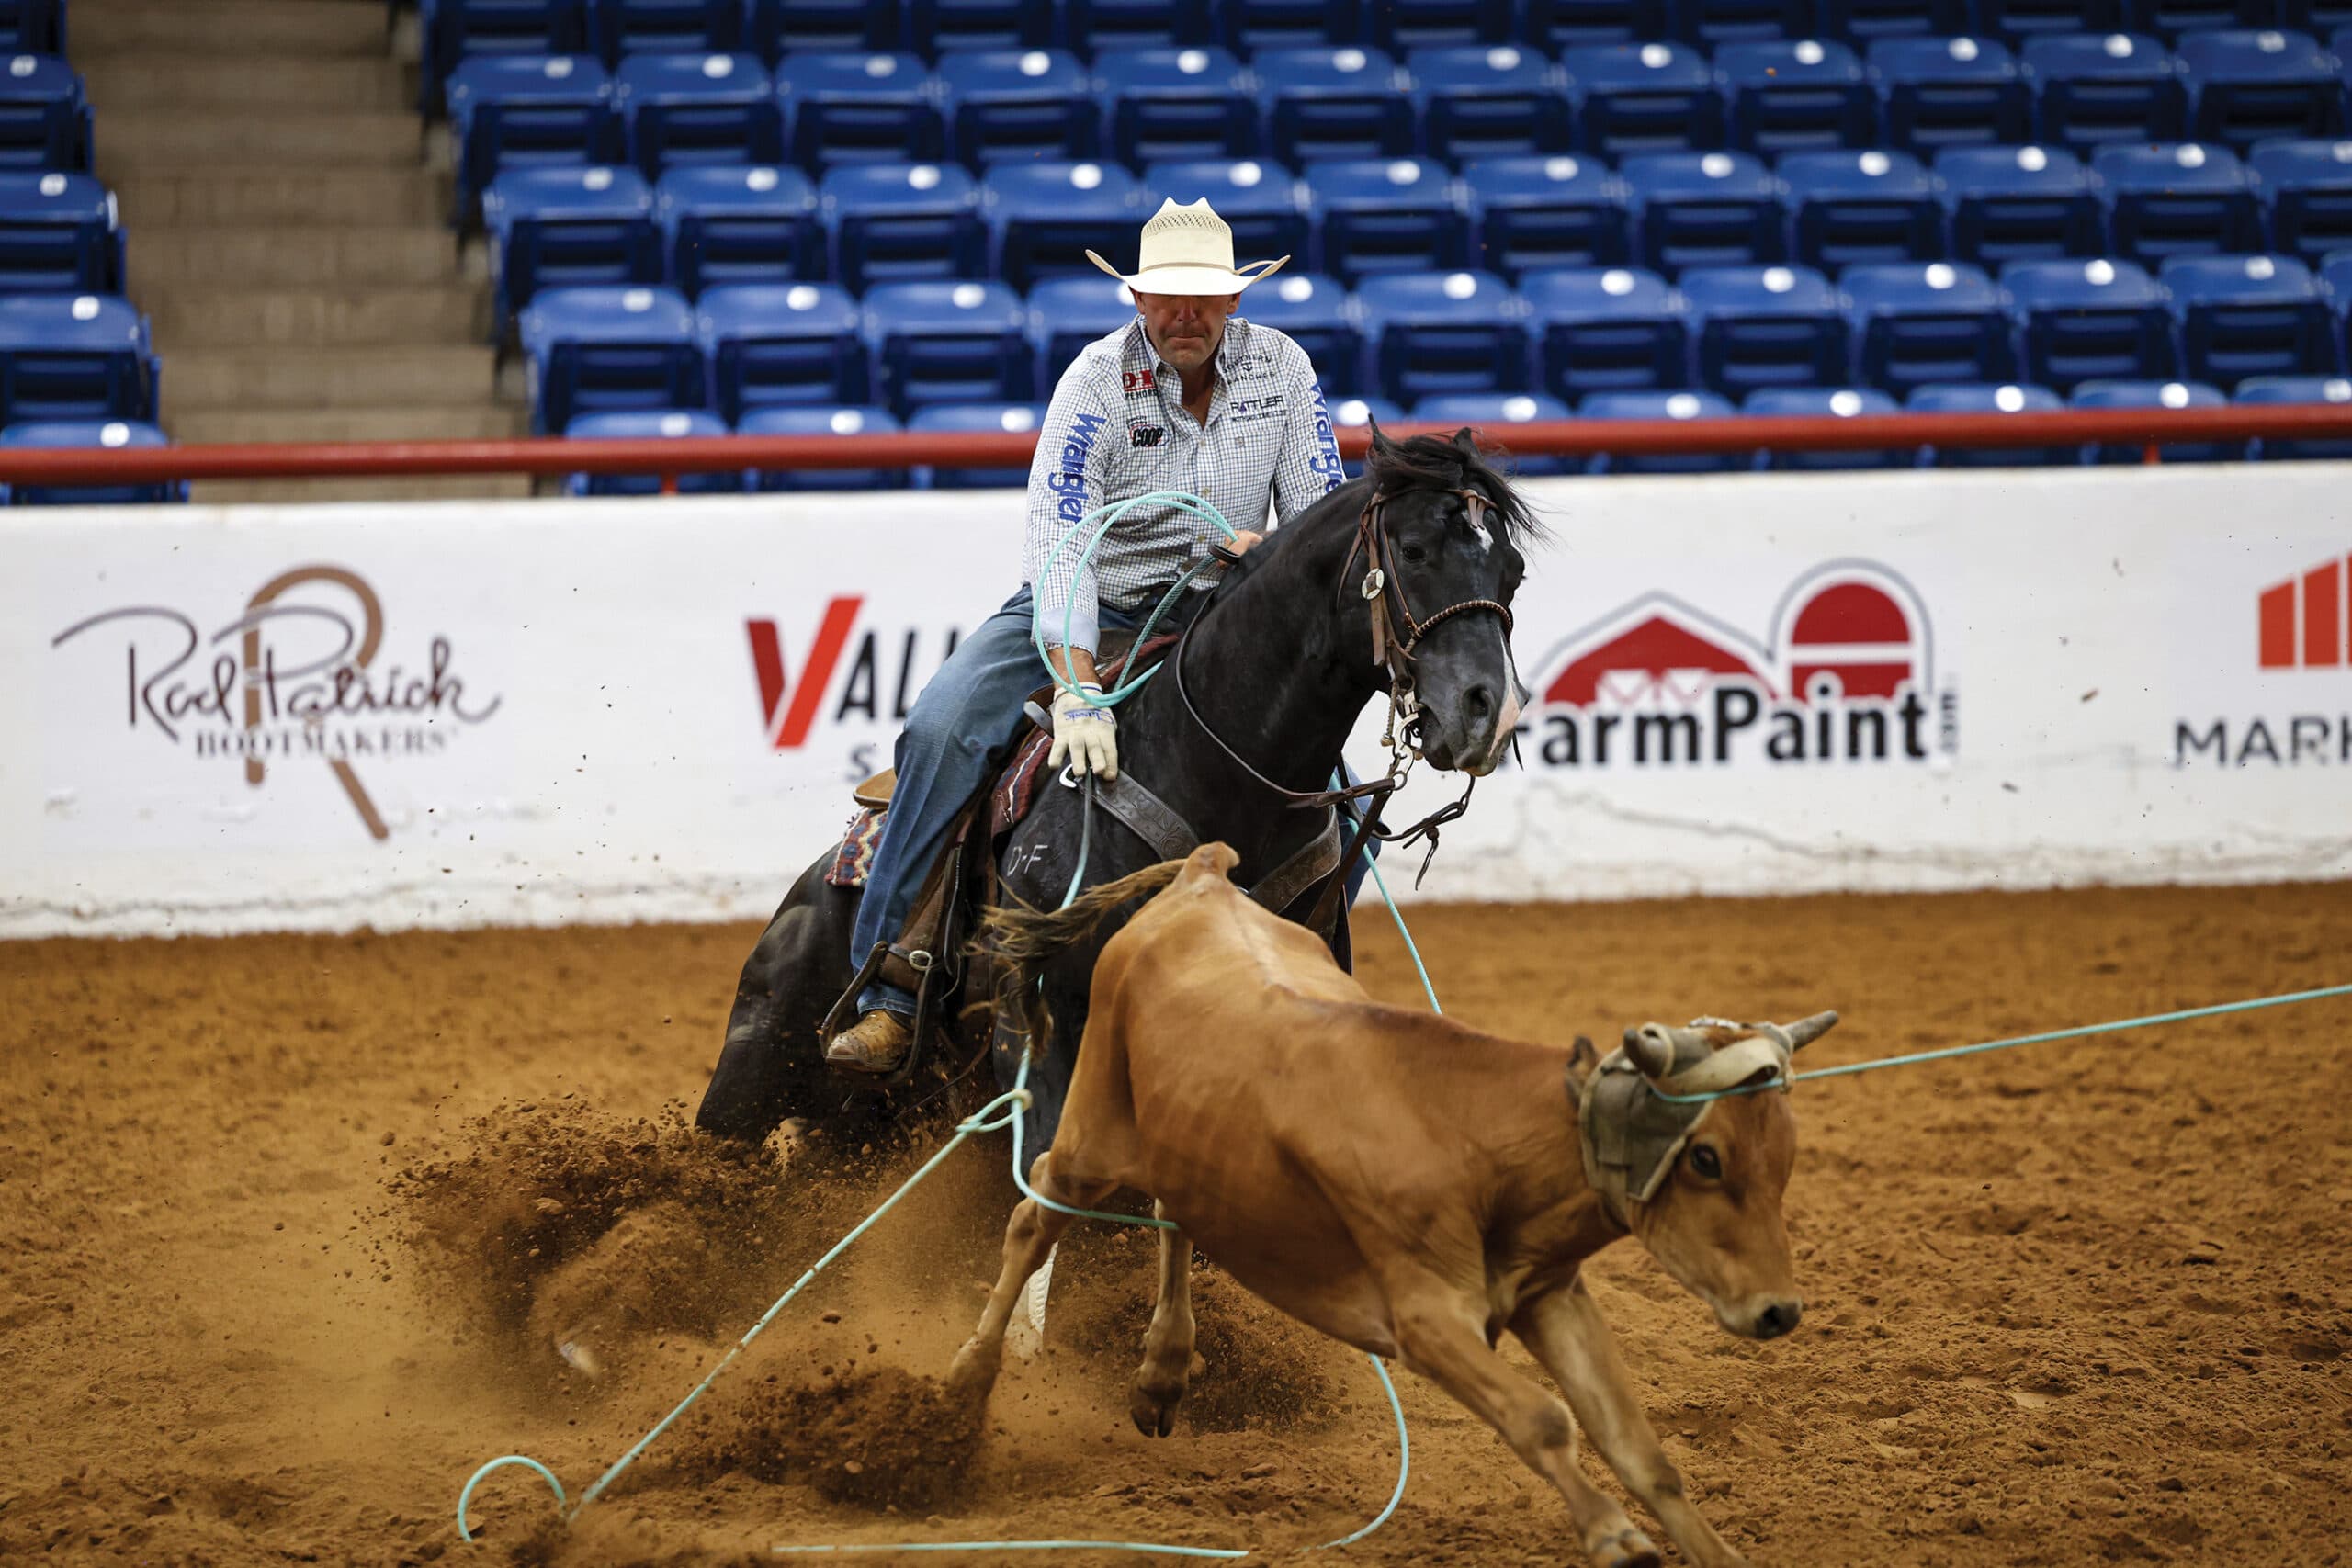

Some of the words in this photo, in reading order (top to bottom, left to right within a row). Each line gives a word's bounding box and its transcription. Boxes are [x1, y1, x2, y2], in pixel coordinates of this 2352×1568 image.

[1230, 395, 1284, 412] RATTLER
[1047, 412, 1107, 524] Wrangler
[1132, 427, 1164, 448] COOP
[210, 604, 502, 726] Patrick
